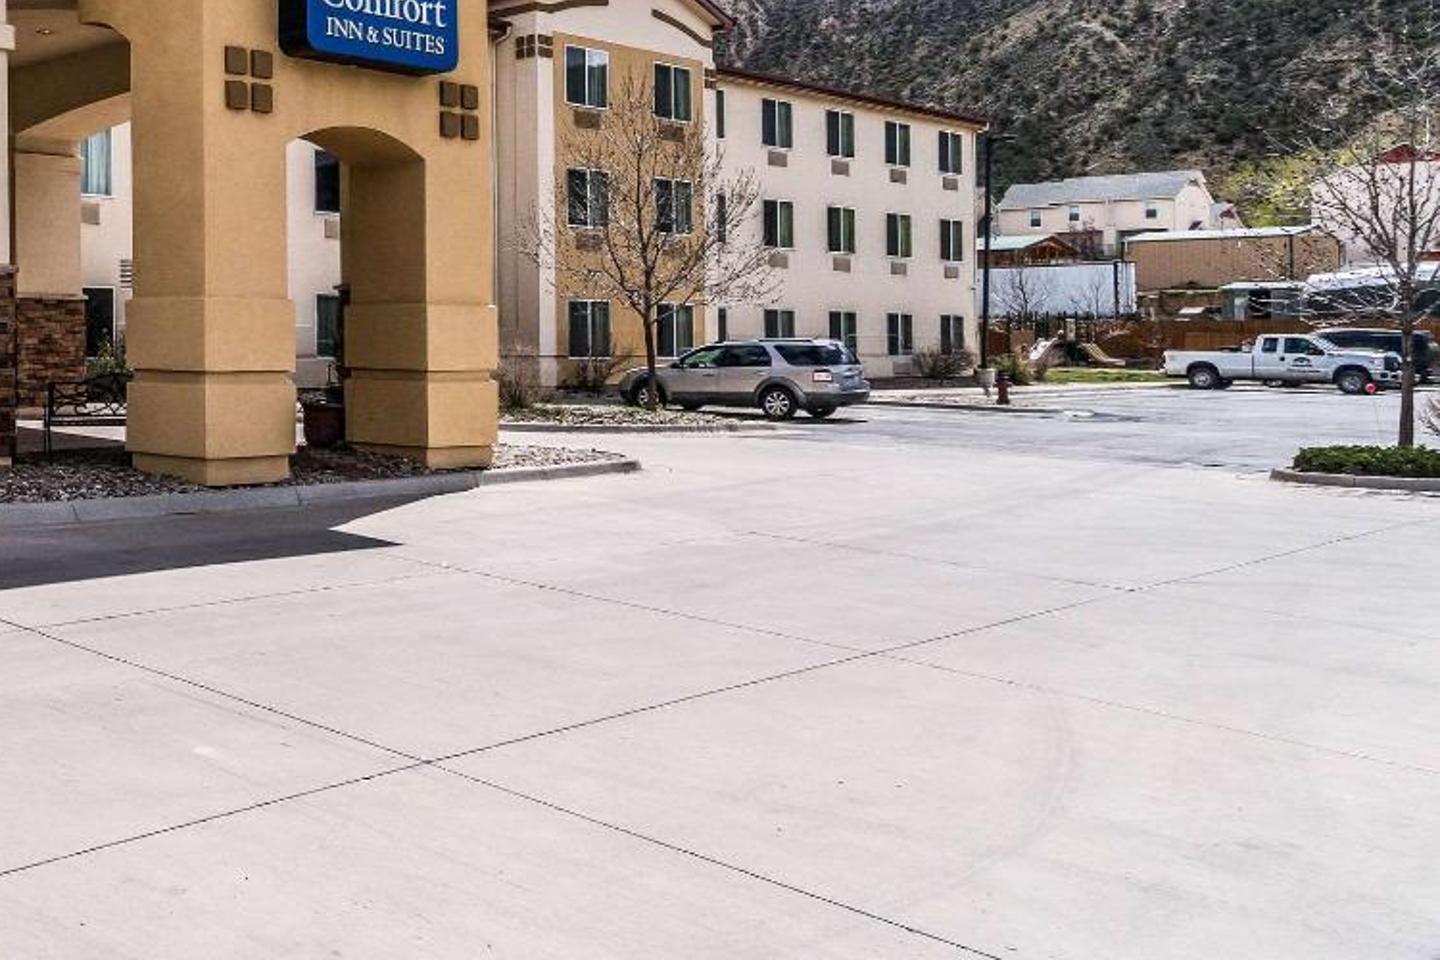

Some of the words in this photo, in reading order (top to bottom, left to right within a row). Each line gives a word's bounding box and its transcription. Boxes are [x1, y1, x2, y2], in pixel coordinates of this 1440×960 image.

[326, 16, 363, 40] INN
[366, 25, 380, 44] &
[382, 28, 445, 55] SUITES
